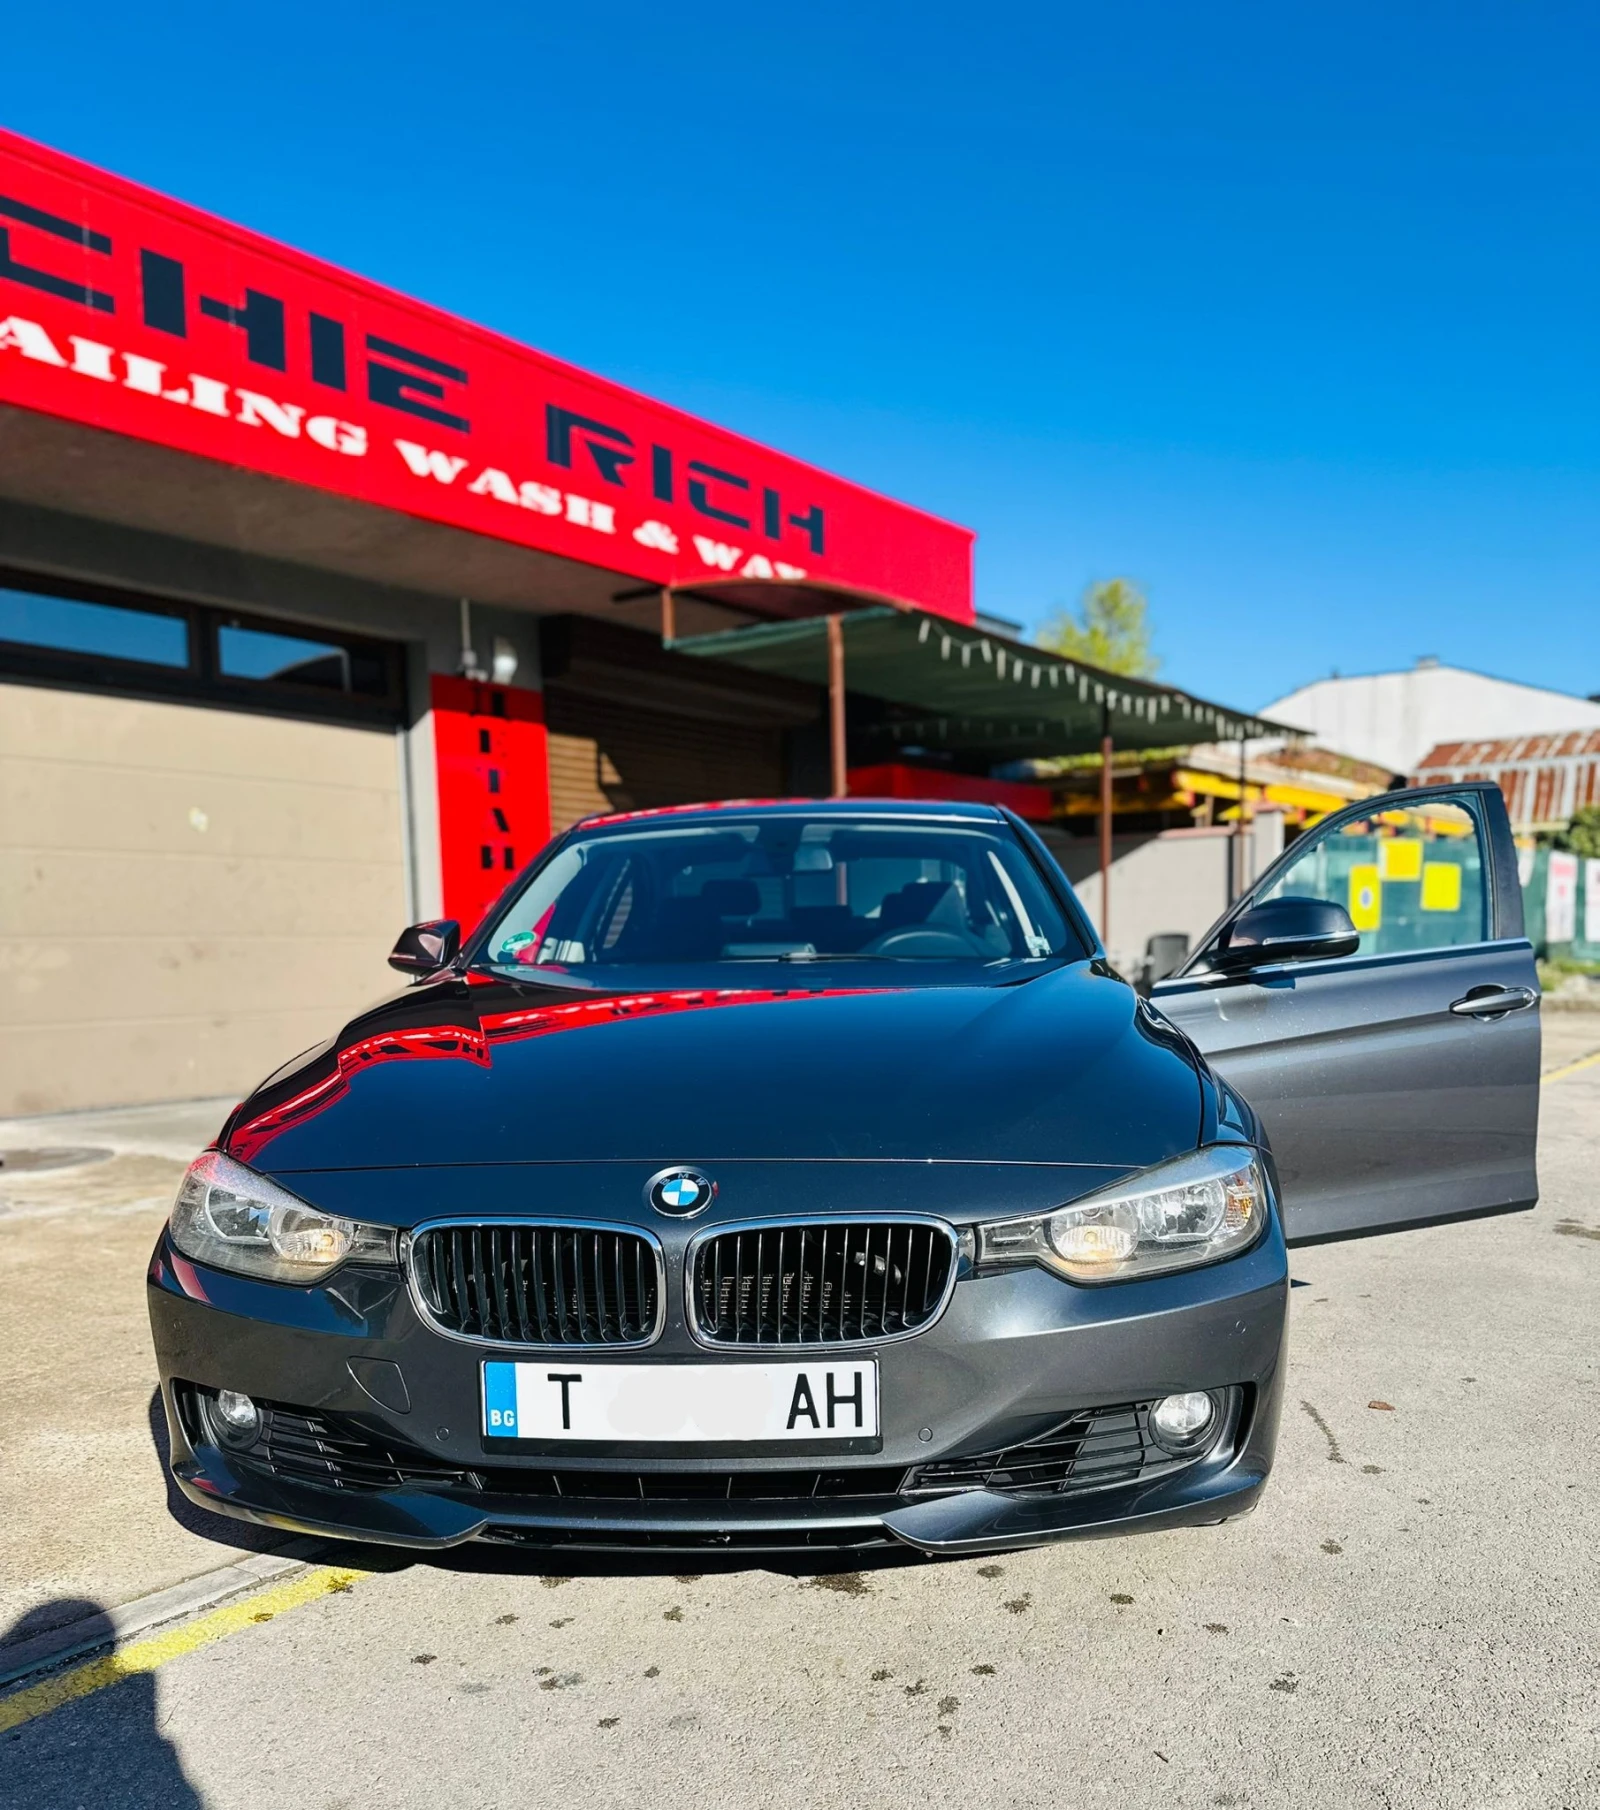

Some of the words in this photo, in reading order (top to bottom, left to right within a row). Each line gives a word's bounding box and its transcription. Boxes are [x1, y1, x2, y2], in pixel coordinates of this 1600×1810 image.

[394, 438, 616, 534] WASH
[632, 520, 679, 555] &
[545, 404, 825, 556] RICH
[659, 1172, 707, 1187] BMW
[490, 1409, 515, 1427] BG
[547, 1373, 582, 1430] T
[786, 1371, 863, 1430] AH
